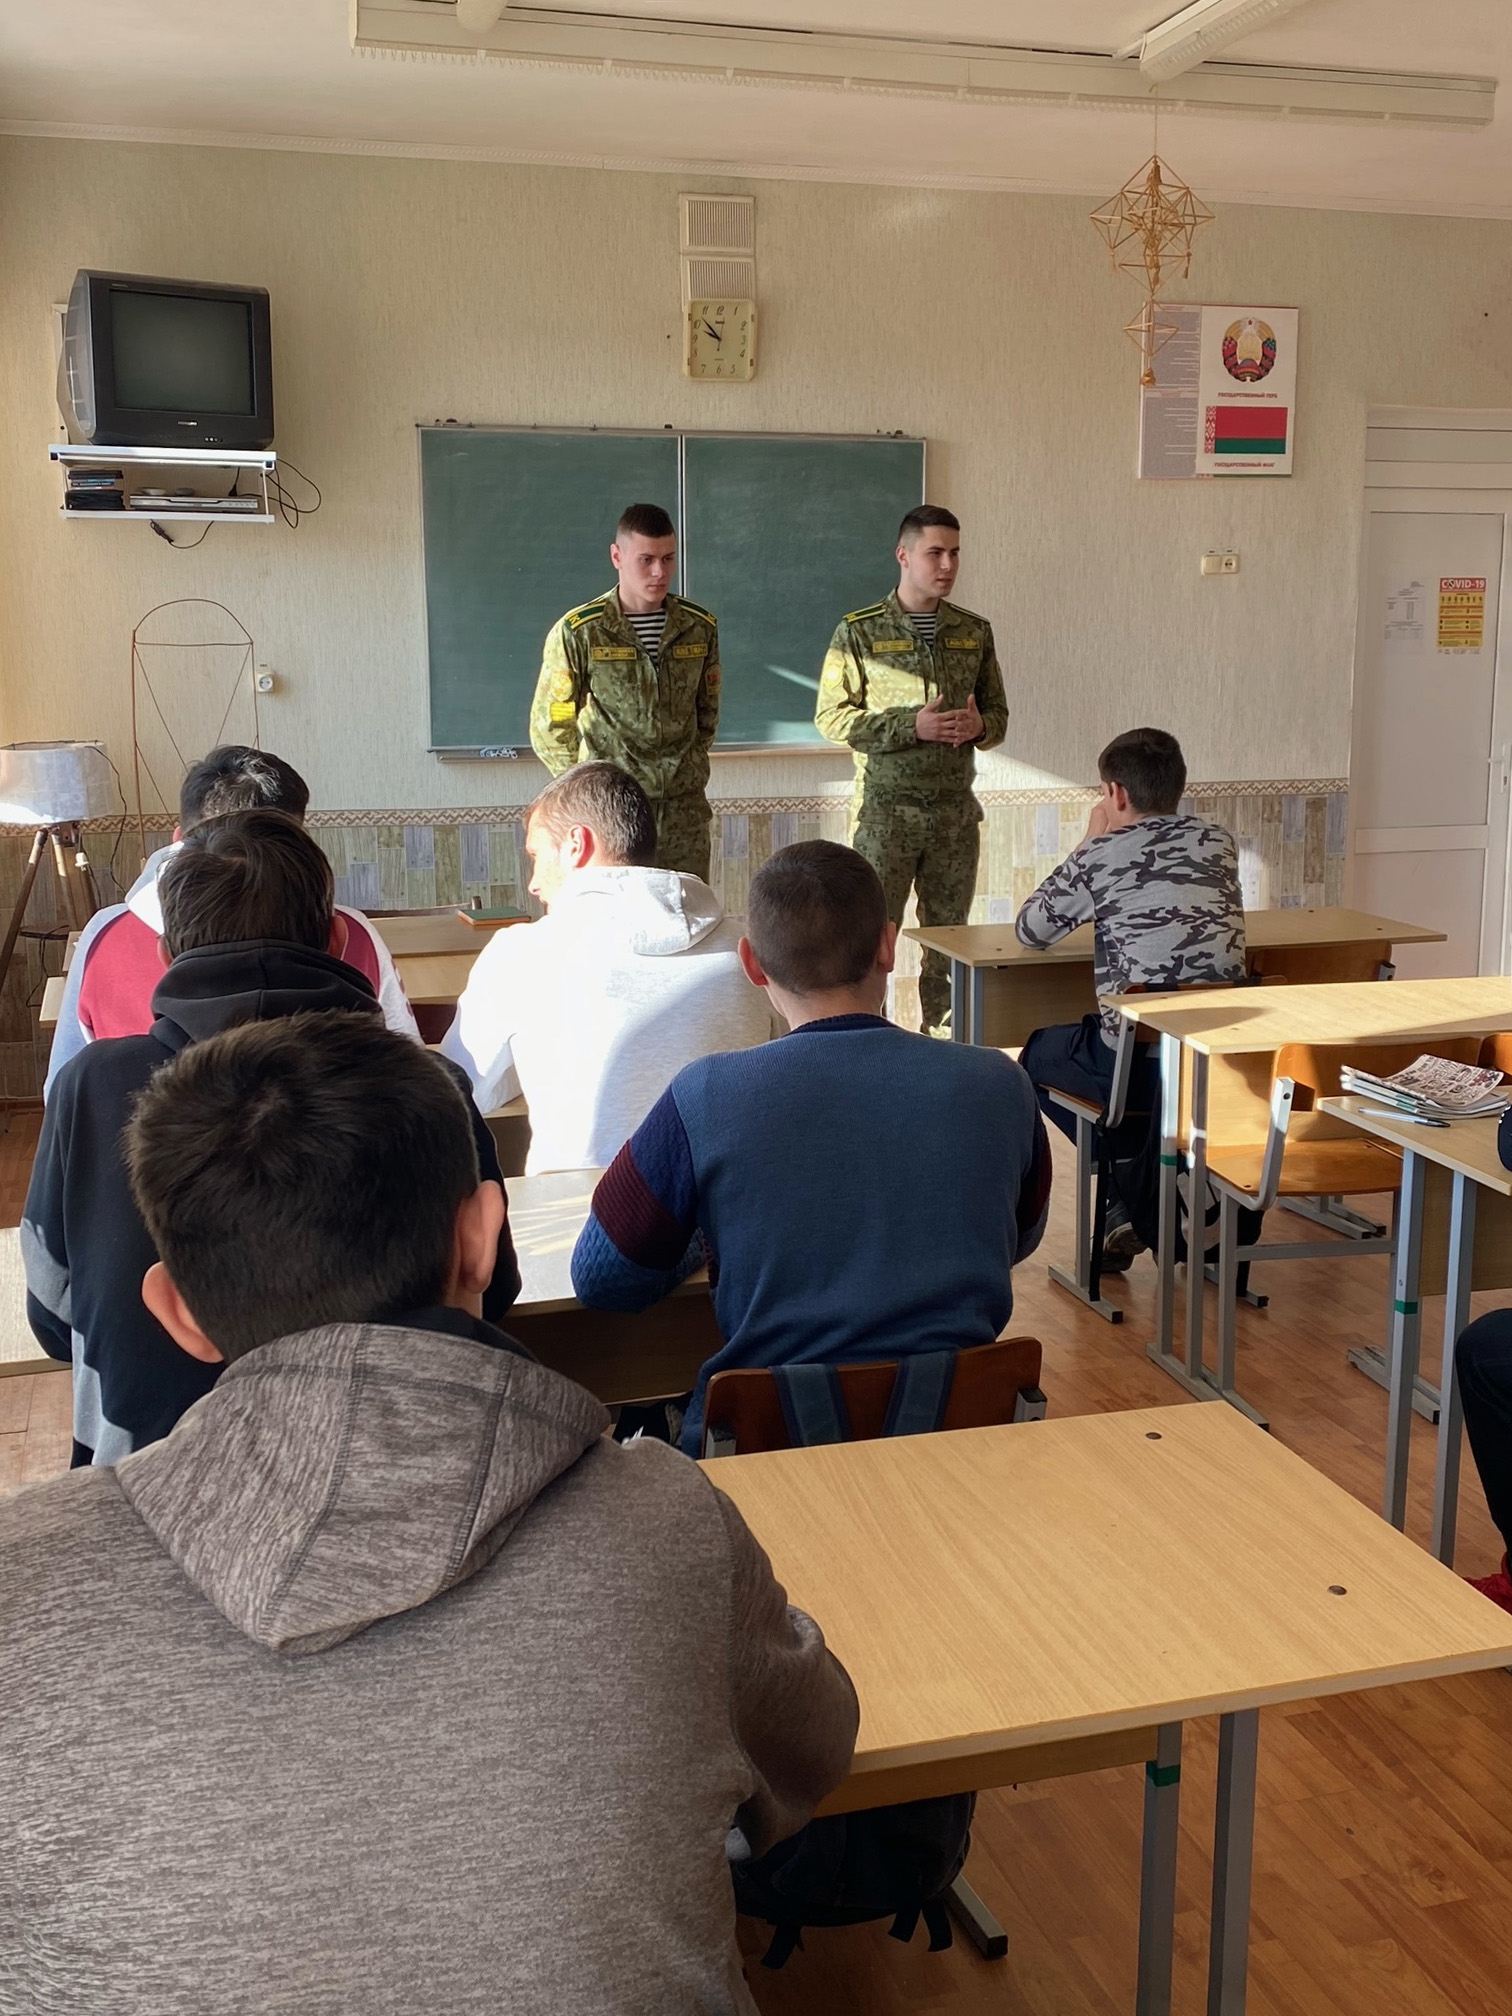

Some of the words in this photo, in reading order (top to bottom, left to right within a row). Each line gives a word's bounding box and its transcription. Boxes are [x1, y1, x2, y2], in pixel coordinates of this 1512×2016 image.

[702, 305, 709, 315] 11
[716, 305, 725, 316] 12
[693, 319, 701, 329] 10
[740, 320, 747, 330] 2
[741, 335, 746, 345] 3
[739, 349, 746, 358] 4
[716, 364, 722, 375] 6
[730, 364, 736, 374] 5
[1441, 579, 1485, 589] COVID-19
